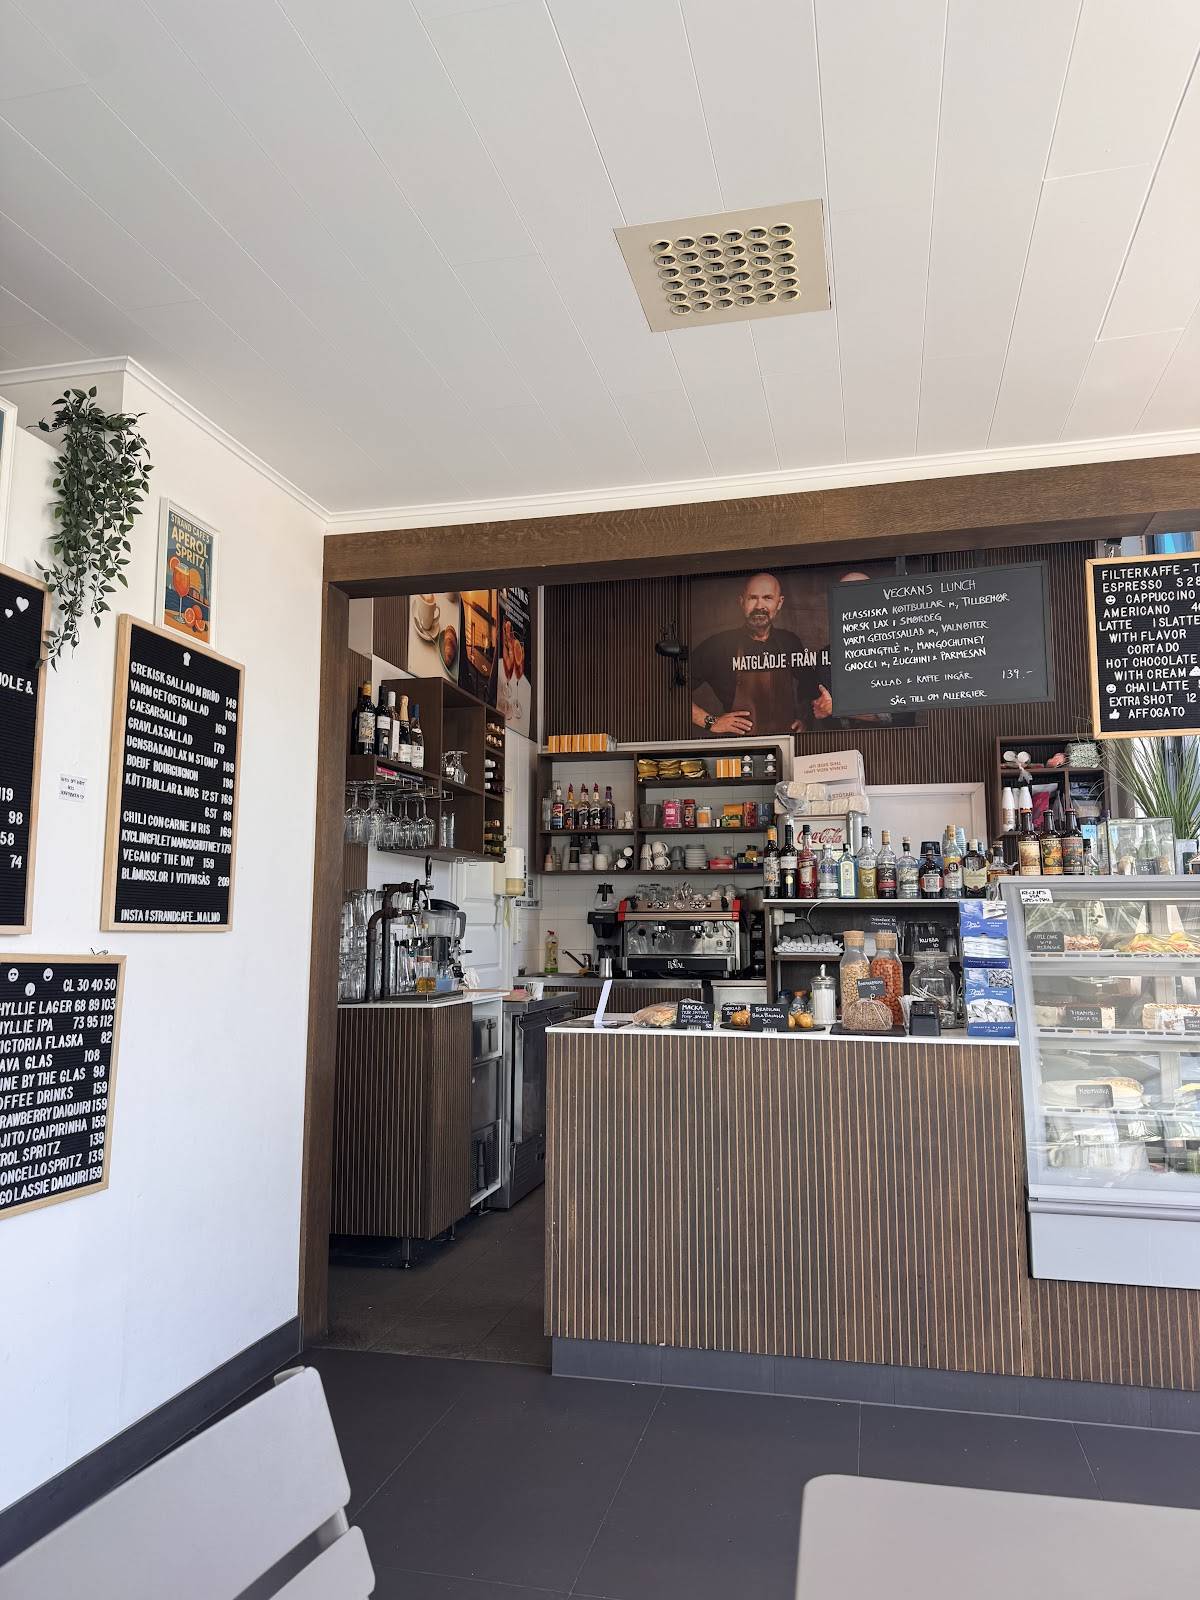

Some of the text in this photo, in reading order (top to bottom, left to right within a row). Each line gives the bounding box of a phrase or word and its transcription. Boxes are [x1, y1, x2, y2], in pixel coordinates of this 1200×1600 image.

[172, 526, 209, 558] APEROL
[176, 543, 206, 569] SPRITZ
[1102, 564, 1180, 580] FILTERKAFFE
[883, 579, 976, 600] VECKANS LUNCH
[1102, 579, 1162, 593] ESPRESSO
[1126, 589, 1195, 604] CAPPUCCINO
[842, 607, 888, 621] KLASSISKA
[1103, 604, 1170, 618] AMERICANO
[842, 621, 870, 634] NORSK
[873, 619, 889, 629] LAX
[1099, 619, 1132, 631] LATTE
[843, 635, 865, 647] VARM
[867, 627, 925, 643] GETOSTSALLAD
[916, 635, 985, 650] MANGOCHUTNEY
[1109, 629, 1187, 643] WITH FLAVOR
[1128, 642, 1179, 655] CORTADO
[732, 648, 817, 671] MATGLÄDJE FRÅN
[844, 660, 877, 672] GNOCCI
[892, 655, 931, 666] ZUCCHINI
[940, 646, 987, 661] PARMESAN
[1106, 654, 1197, 669] HOT CHOCOLATE
[870, 677, 902, 688] SALLAD
[944, 671, 974, 681] INGÅR
[1114, 667, 1186, 681] WITH CREAM
[25, 681, 34, 695] &
[130, 679, 152, 697] VARM
[131, 661, 237, 709] GREKISK SALLAD M BRÖD 149
[1126, 682, 1149, 693] CHAI
[1153, 680, 1189, 691] LATTE
[889, 689, 988, 706] SÅG TILL OM ALLERGIER
[1110, 693, 1197, 707] EXTRA SHOT 12
[1129, 707, 1185, 719] AFFOGATO
[215, 723, 226, 735] 169
[127, 735, 234, 773] UGNSBAKAD LAX M STOMP 189
[214, 742, 225, 754] 179
[127, 754, 151, 770] BOEUF
[153, 760, 199, 781] BOURGUIGNON
[177, 784, 183, 796] &
[184, 786, 199, 799] MOS
[201, 789, 210, 801] 12
[210, 791, 219, 802] ST
[221, 794, 232, 805] 169
[8, 811, 23, 825] 98
[210, 808, 218, 819] ST
[223, 811, 232, 821] 89
[123, 810, 231, 838] CHILI CON CARNE M RIS 169
[221, 843, 231, 854] 179
[10, 854, 22, 869] 74
[123, 848, 214, 869] VEGAN OF THE DAY 159
[176, 871, 210, 885] VITVINSÅS
[218, 876, 229, 887] 209
[121, 908, 143, 921] INSTA
[63, 978, 116, 992] CL 30 40 50
[39, 1000, 72, 1014] LAGER
[74, 999, 86, 1012] 68
[88, 998, 100, 1011] 89
[101, 998, 115, 1010] 103
[37, 1018, 53, 1032] IPA
[73, 1016, 84, 1029] 73
[87, 1015, 98, 1028] 95
[100, 1015, 113, 1027] 112
[45, 1033, 83, 1049] FLASKA
[101, 1031, 112, 1044] 82
[25, 1054, 53, 1070] GLAS
[84, 1048, 100, 1063] 108
[21, 1073, 35, 1089] BY
[37, 1071, 57, 1086] THE
[60, 1067, 86, 1083] GLAS
[93, 1065, 105, 1078] 98
[37, 1086, 73, 1105] DRINKS
[93, 1081, 107, 1095] 159
[53, 1100, 91, 1119] DAIQUIRI
[92, 1097, 107, 1112] 159
[92, 1115, 106, 1129] 159
[22, 1132, 104, 1161] SPRITZ 139
[48, 1153, 82, 1174] SPRITZ
[88, 1149, 104, 1164] 139
[14, 1179, 50, 1201] LASSIE
[51, 1169, 88, 1191] DAIQUIRI
[89, 1166, 102, 1181] 159
